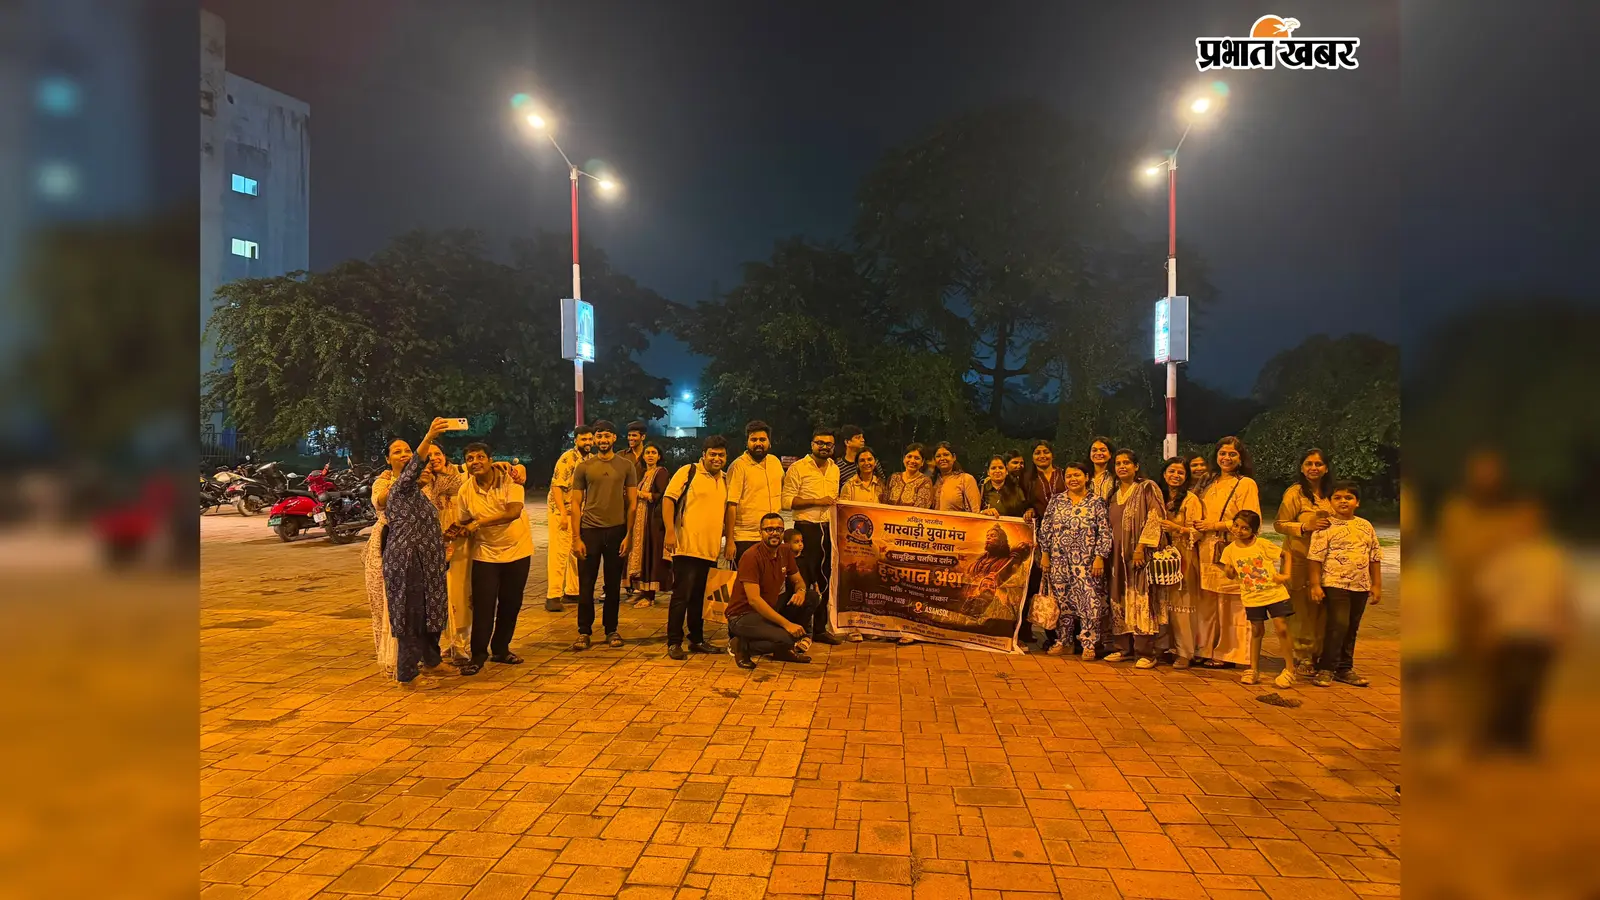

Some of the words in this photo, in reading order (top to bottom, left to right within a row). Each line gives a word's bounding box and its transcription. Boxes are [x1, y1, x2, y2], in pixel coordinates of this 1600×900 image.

[883, 522, 924, 540] मारवाड़ी
[926, 527, 946, 541] युवा
[948, 527, 966, 541] मंच
[894, 538, 930, 551] जामताड़ा
[932, 541, 955, 552] शाखा
[892, 553, 915, 562] सामूहिक
[917, 554, 938, 563] चलचित्र
[939, 557, 953, 565] दर्शन
[877, 561, 931, 585] हनुमान
[933, 568, 964, 588] अंश
[869, 592, 893, 601] SEPTEMBER
[924, 606, 949, 617] ASANSOL
